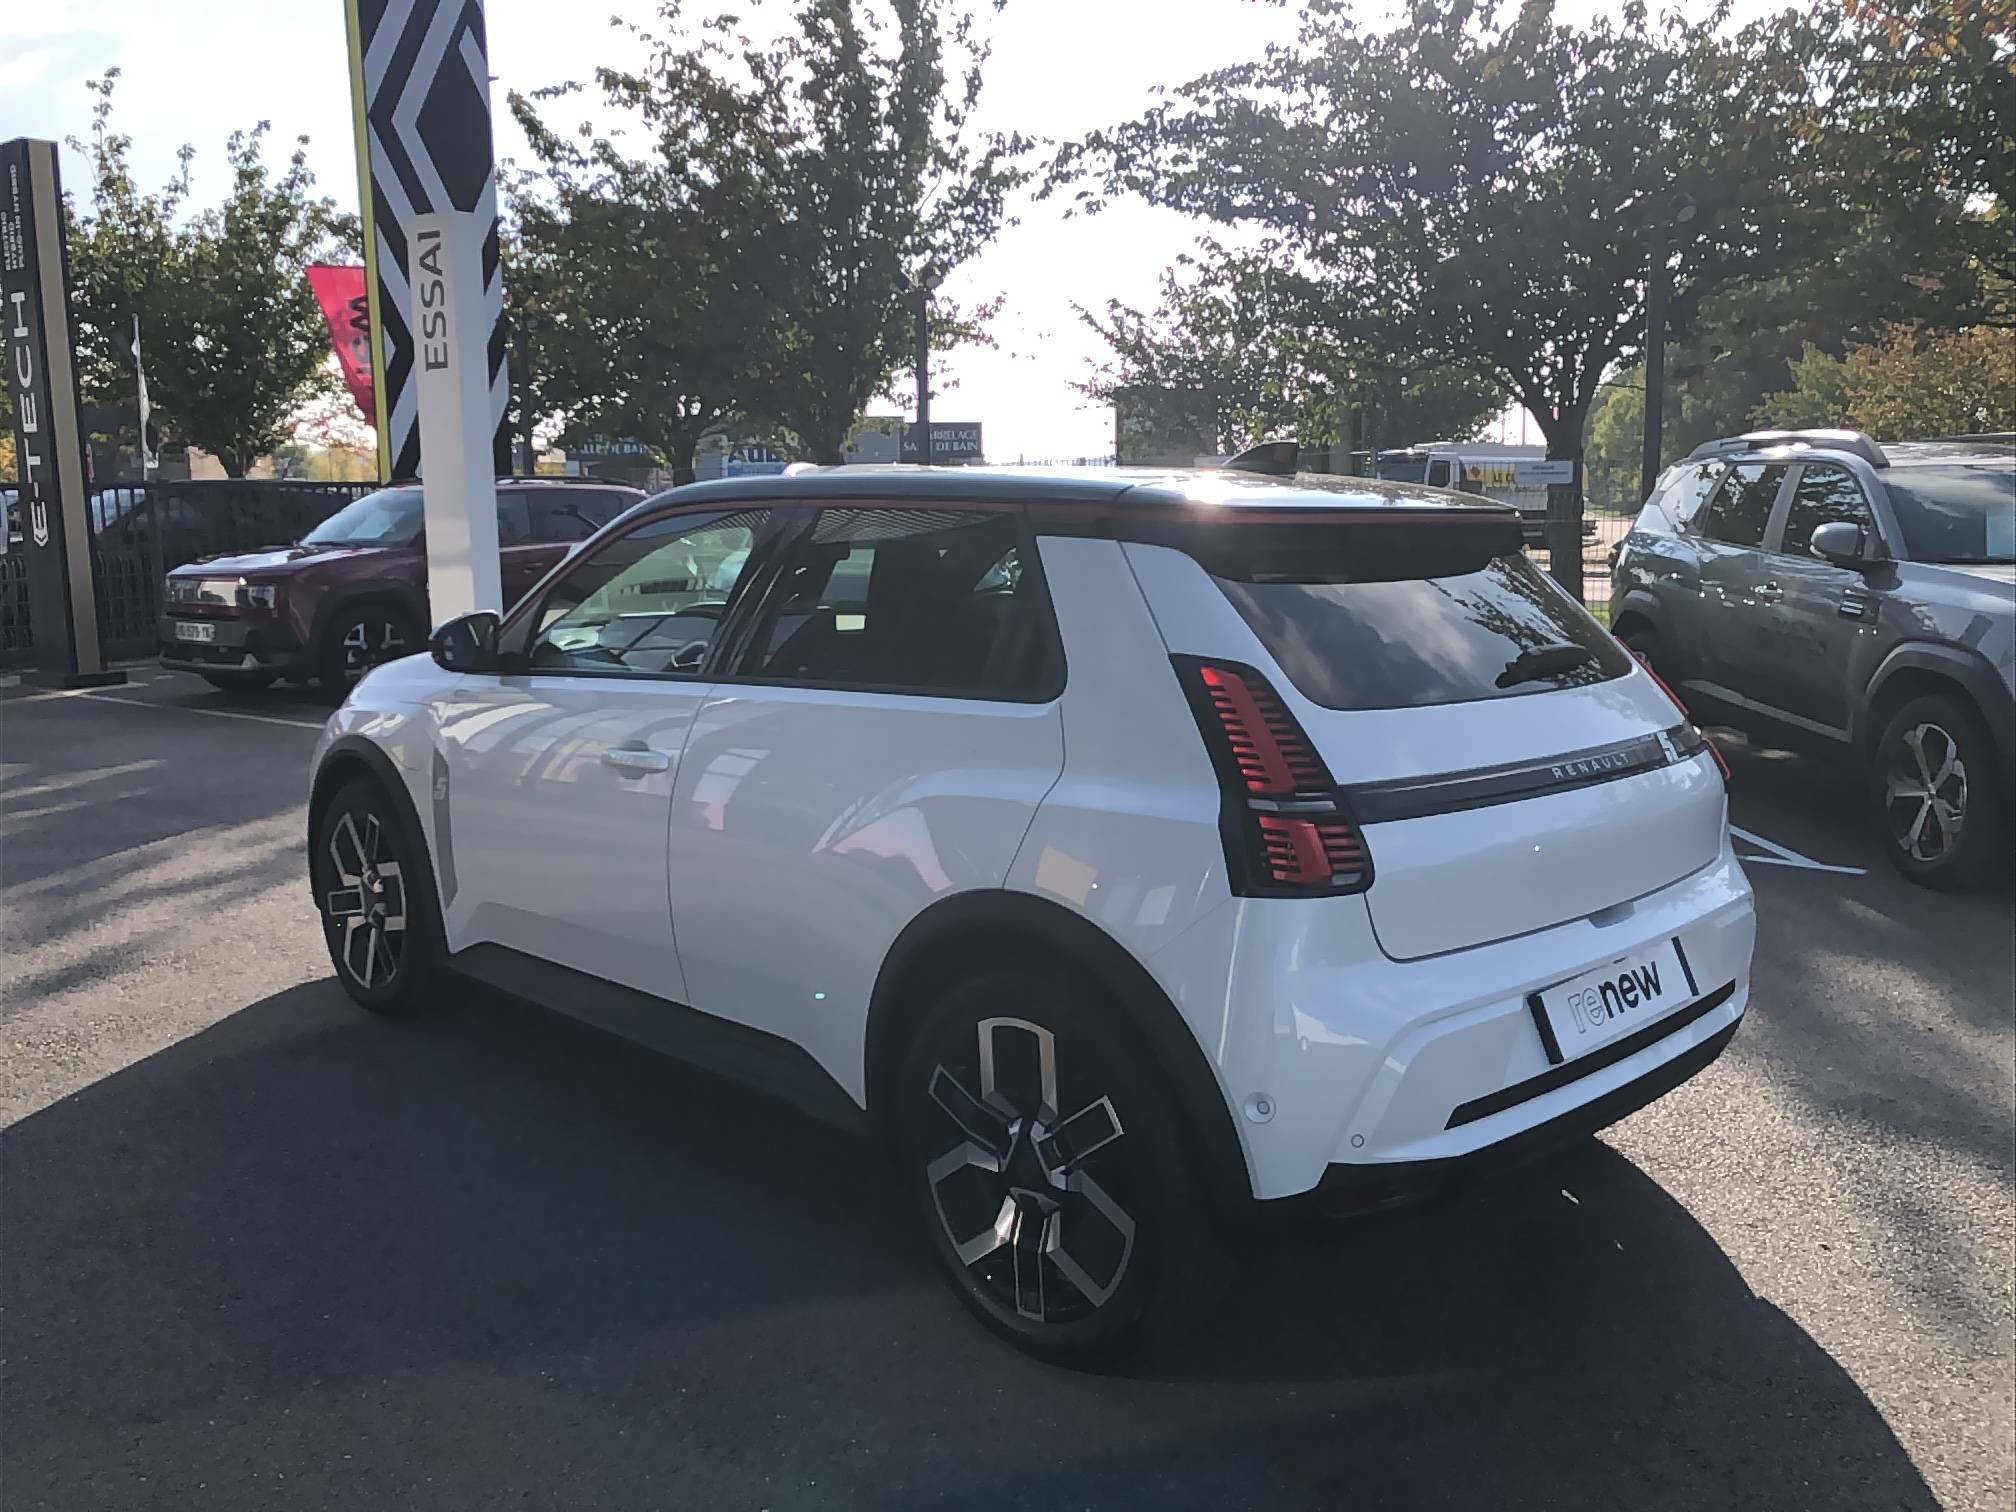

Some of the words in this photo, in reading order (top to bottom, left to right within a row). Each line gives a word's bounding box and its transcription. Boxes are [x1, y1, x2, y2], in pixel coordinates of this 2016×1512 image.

[10, 163, 20, 212] HYBRID
[1, 211, 11, 271] ELECTRIC
[9, 221, 18, 270] HYBRID
[15, 215, 24, 268] PLUG-IN
[417, 230, 448, 372] ESSAI
[12, 291, 49, 547] E-TECH
[1551, 753, 1630, 779] RENAULT
[1567, 960, 1662, 1034] renew
